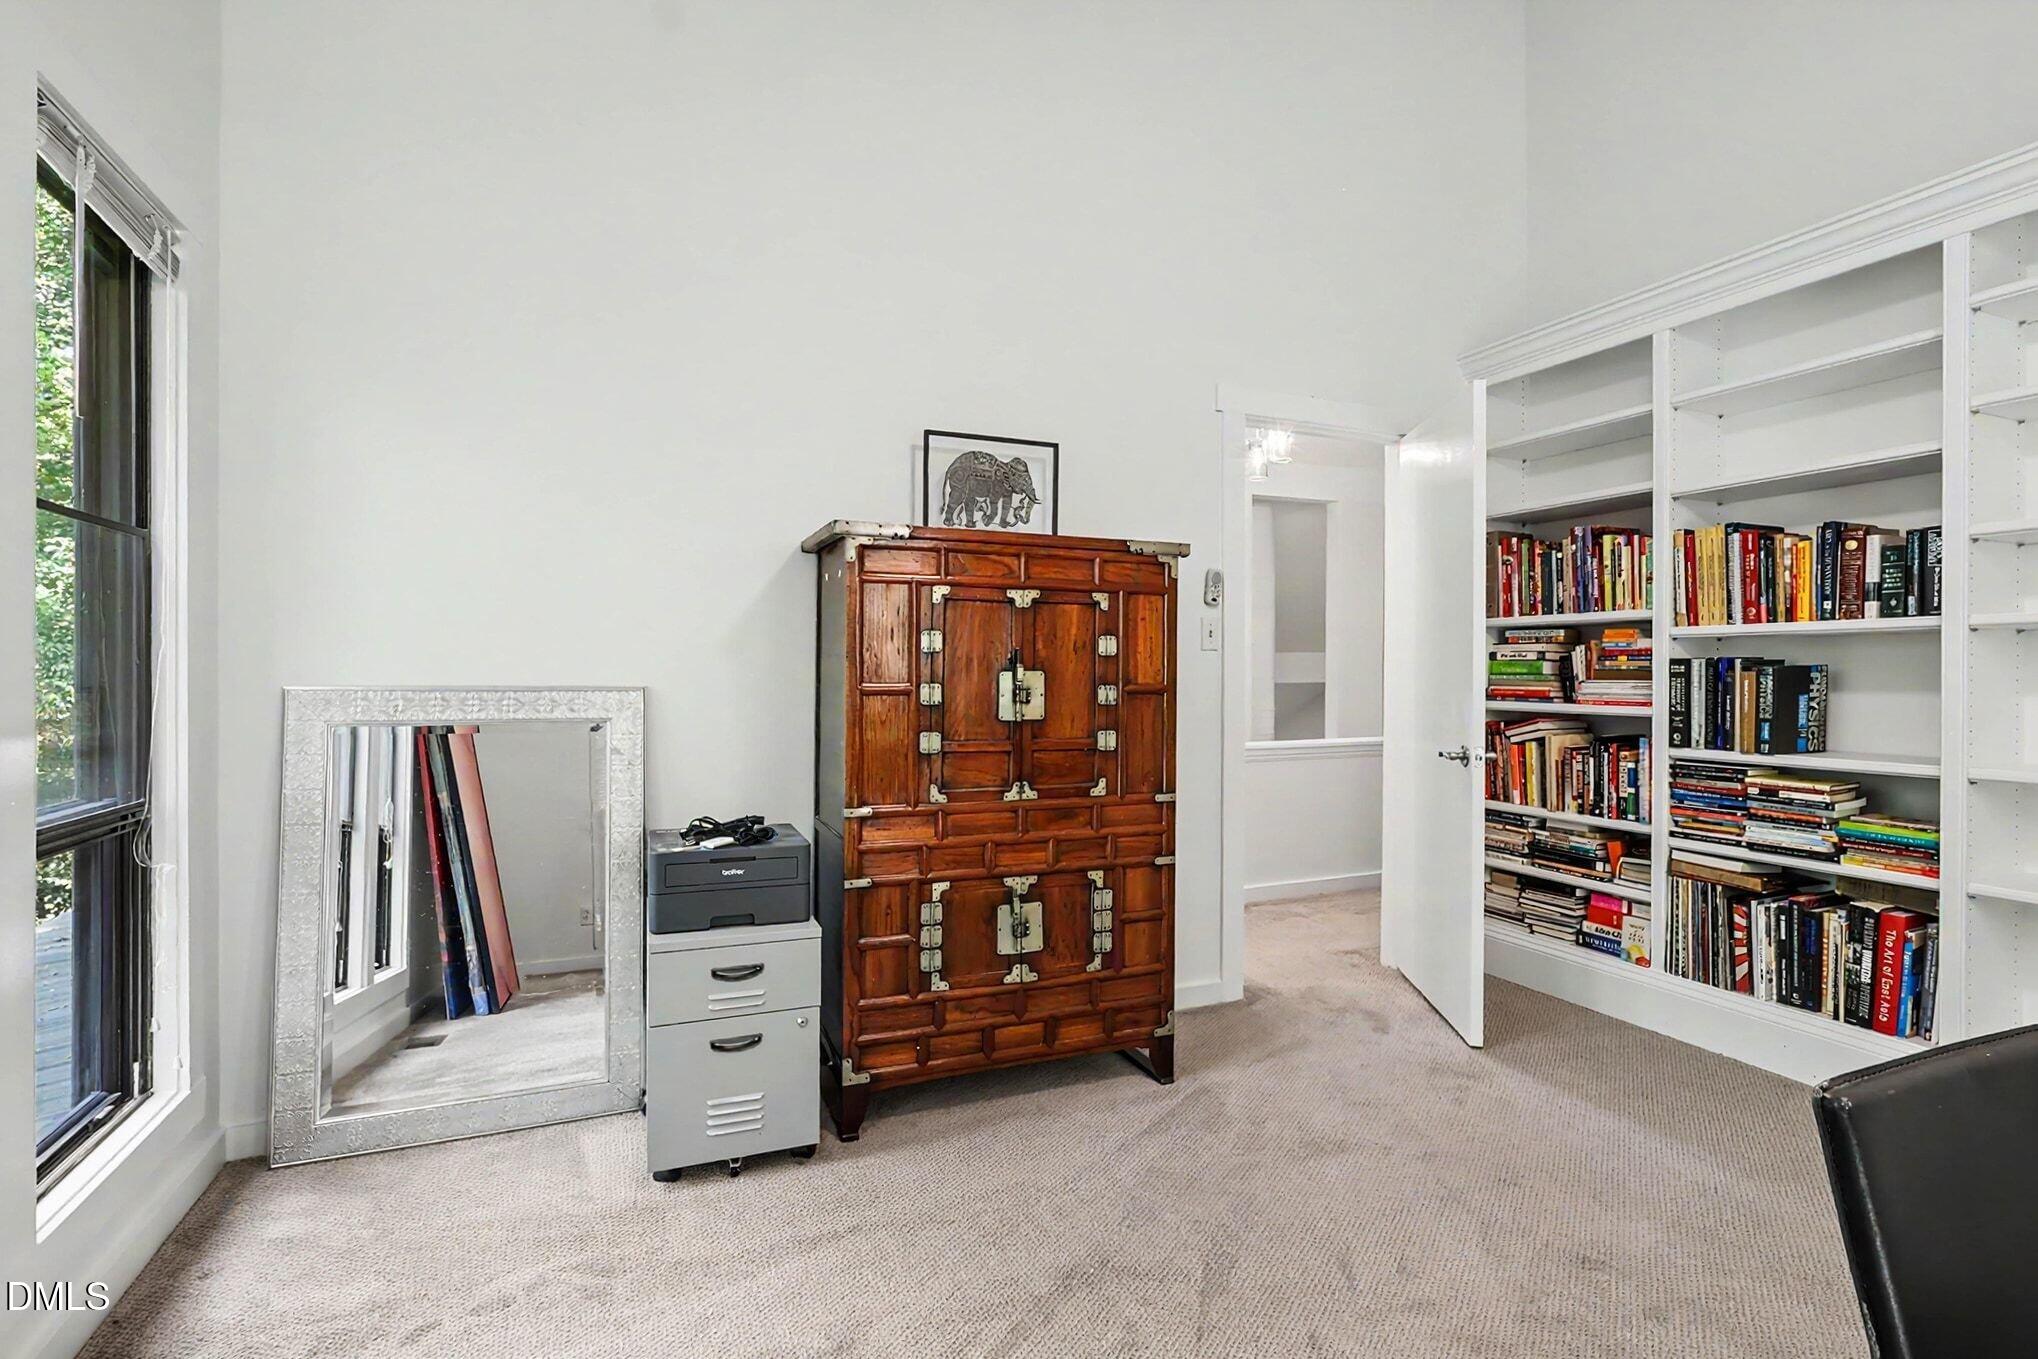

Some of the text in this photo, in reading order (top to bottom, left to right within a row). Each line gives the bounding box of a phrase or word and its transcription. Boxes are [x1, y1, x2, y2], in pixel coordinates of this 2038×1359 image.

[1807, 672, 1821, 752] PHYSICS
[1878, 929, 1897, 1022] The Art of East Asia
